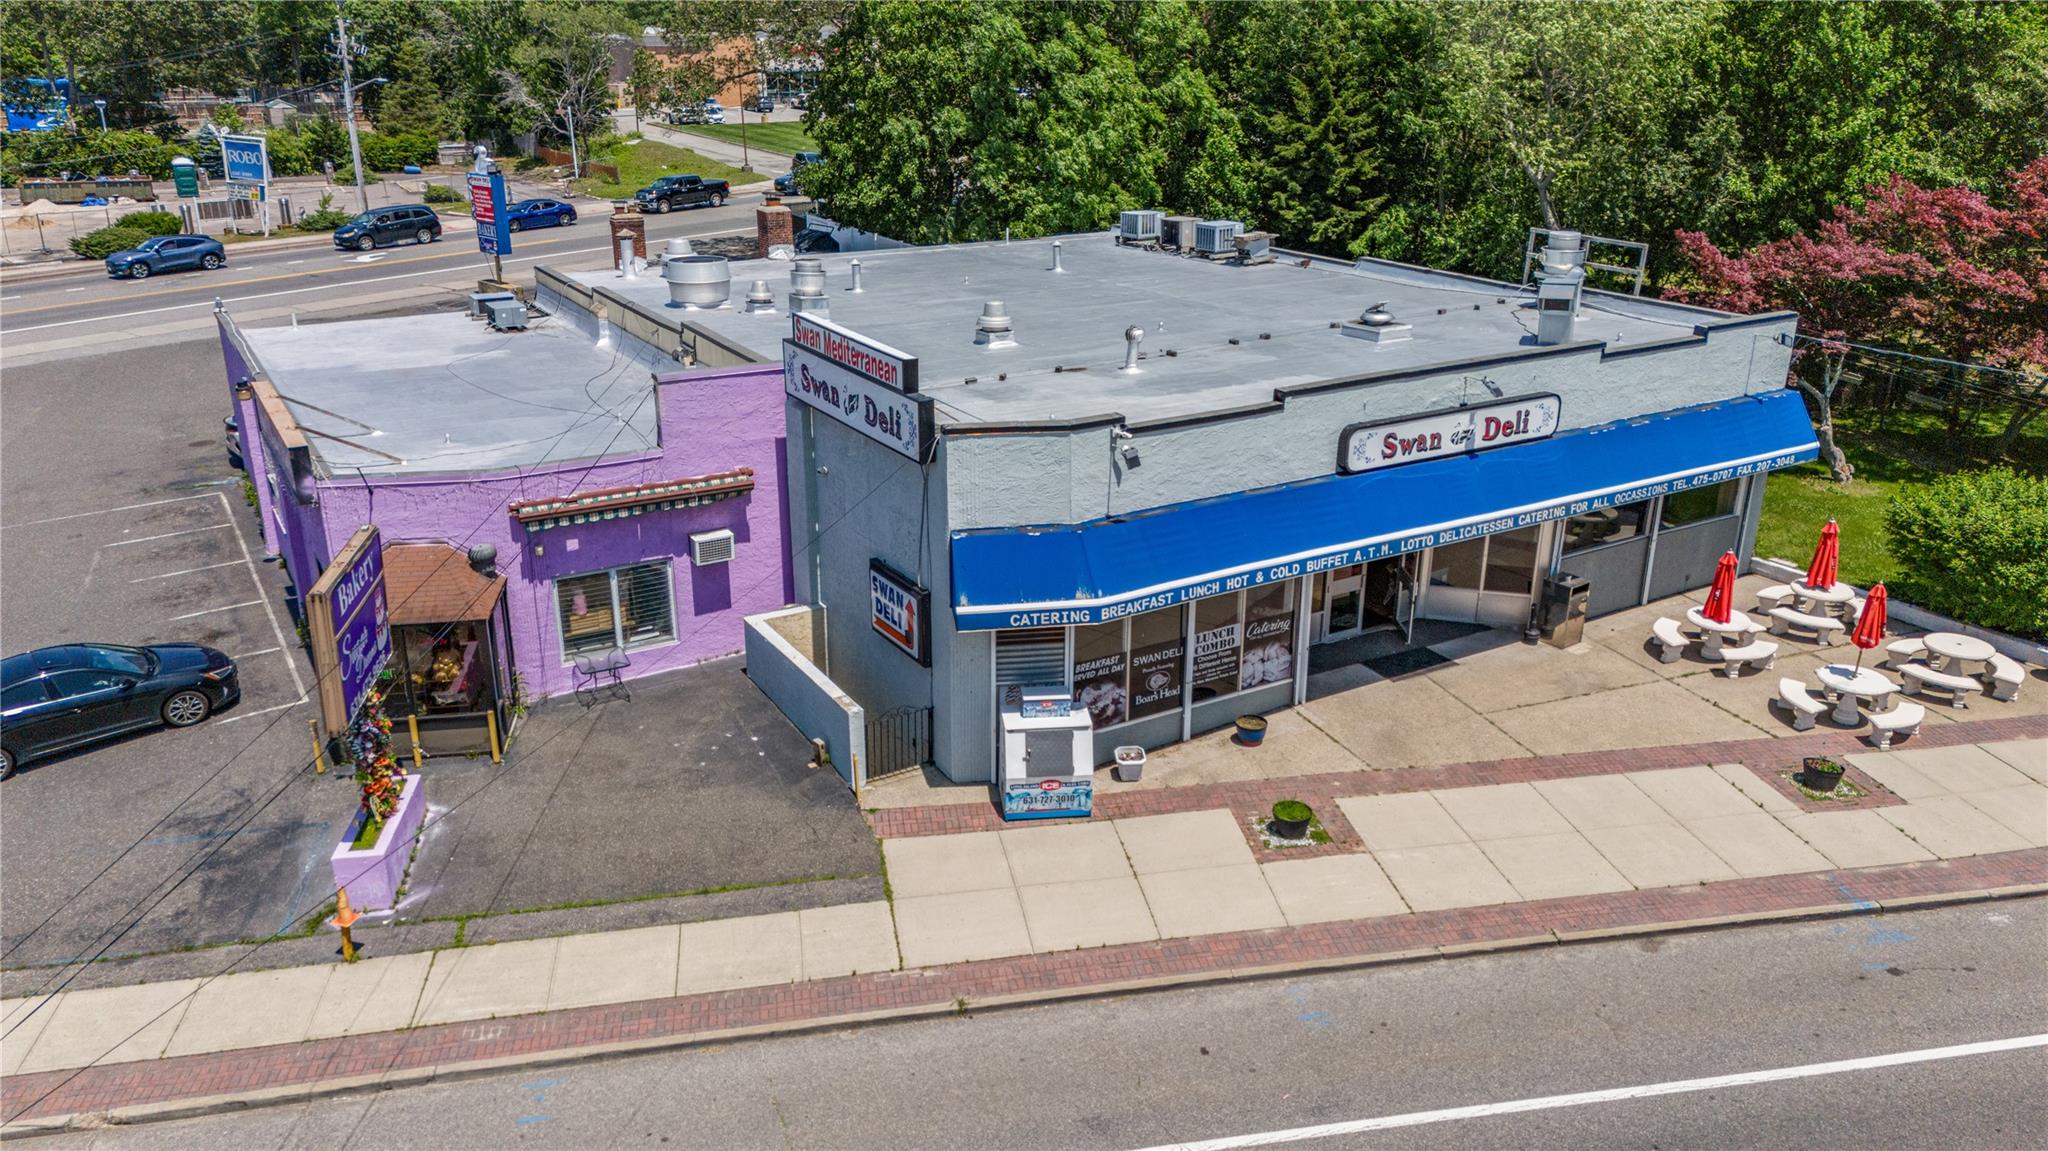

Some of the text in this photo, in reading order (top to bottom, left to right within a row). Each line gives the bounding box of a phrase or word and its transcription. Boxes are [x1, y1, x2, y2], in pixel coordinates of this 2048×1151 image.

[227, 149, 263, 166] ROBO
[795, 318, 898, 386] Swan Mediterranean
[800, 363, 902, 441] Swan Deli
[1381, 409, 1530, 461] Swan Deli
[1010, 610, 1090, 627] CATERING
[1101, 592, 1174, 620] BREAKFAST
[1181, 582, 1220, 601] LUNCH
[1226, 574, 1250, 591] HOT
[1255, 571, 1264, 583] &
[1270, 563, 1300, 580] COLD
[1306, 553, 1349, 572] BUFFET
[1354, 543, 1393, 562] A.T.M.
[1401, 535, 1434, 552] LOTTO
[1439, 517, 1514, 544] DELICATESSEN
[1518, 505, 1566, 526] CATERING
[1570, 501, 1588, 515] FOR
[1592, 496, 1609, 510] ALL
[1614, 482, 1669, 504] OCCASSIONS
[337, 551, 374, 617] Bakery
[872, 575, 904, 612] SWAN
[875, 597, 903, 630] DELI
[1196, 626, 1234, 645] LUNCH
[1246, 618, 1291, 639] Catering
[1194, 637, 1236, 655] COMBO
[1075, 655, 1120, 674] BREAKFAST
[1133, 647, 1184, 667] SWAN DELI
[1097, 667, 1109, 677] ALL
[1111, 663, 1125, 673] DAY
[1160, 685, 1181, 699] Head
